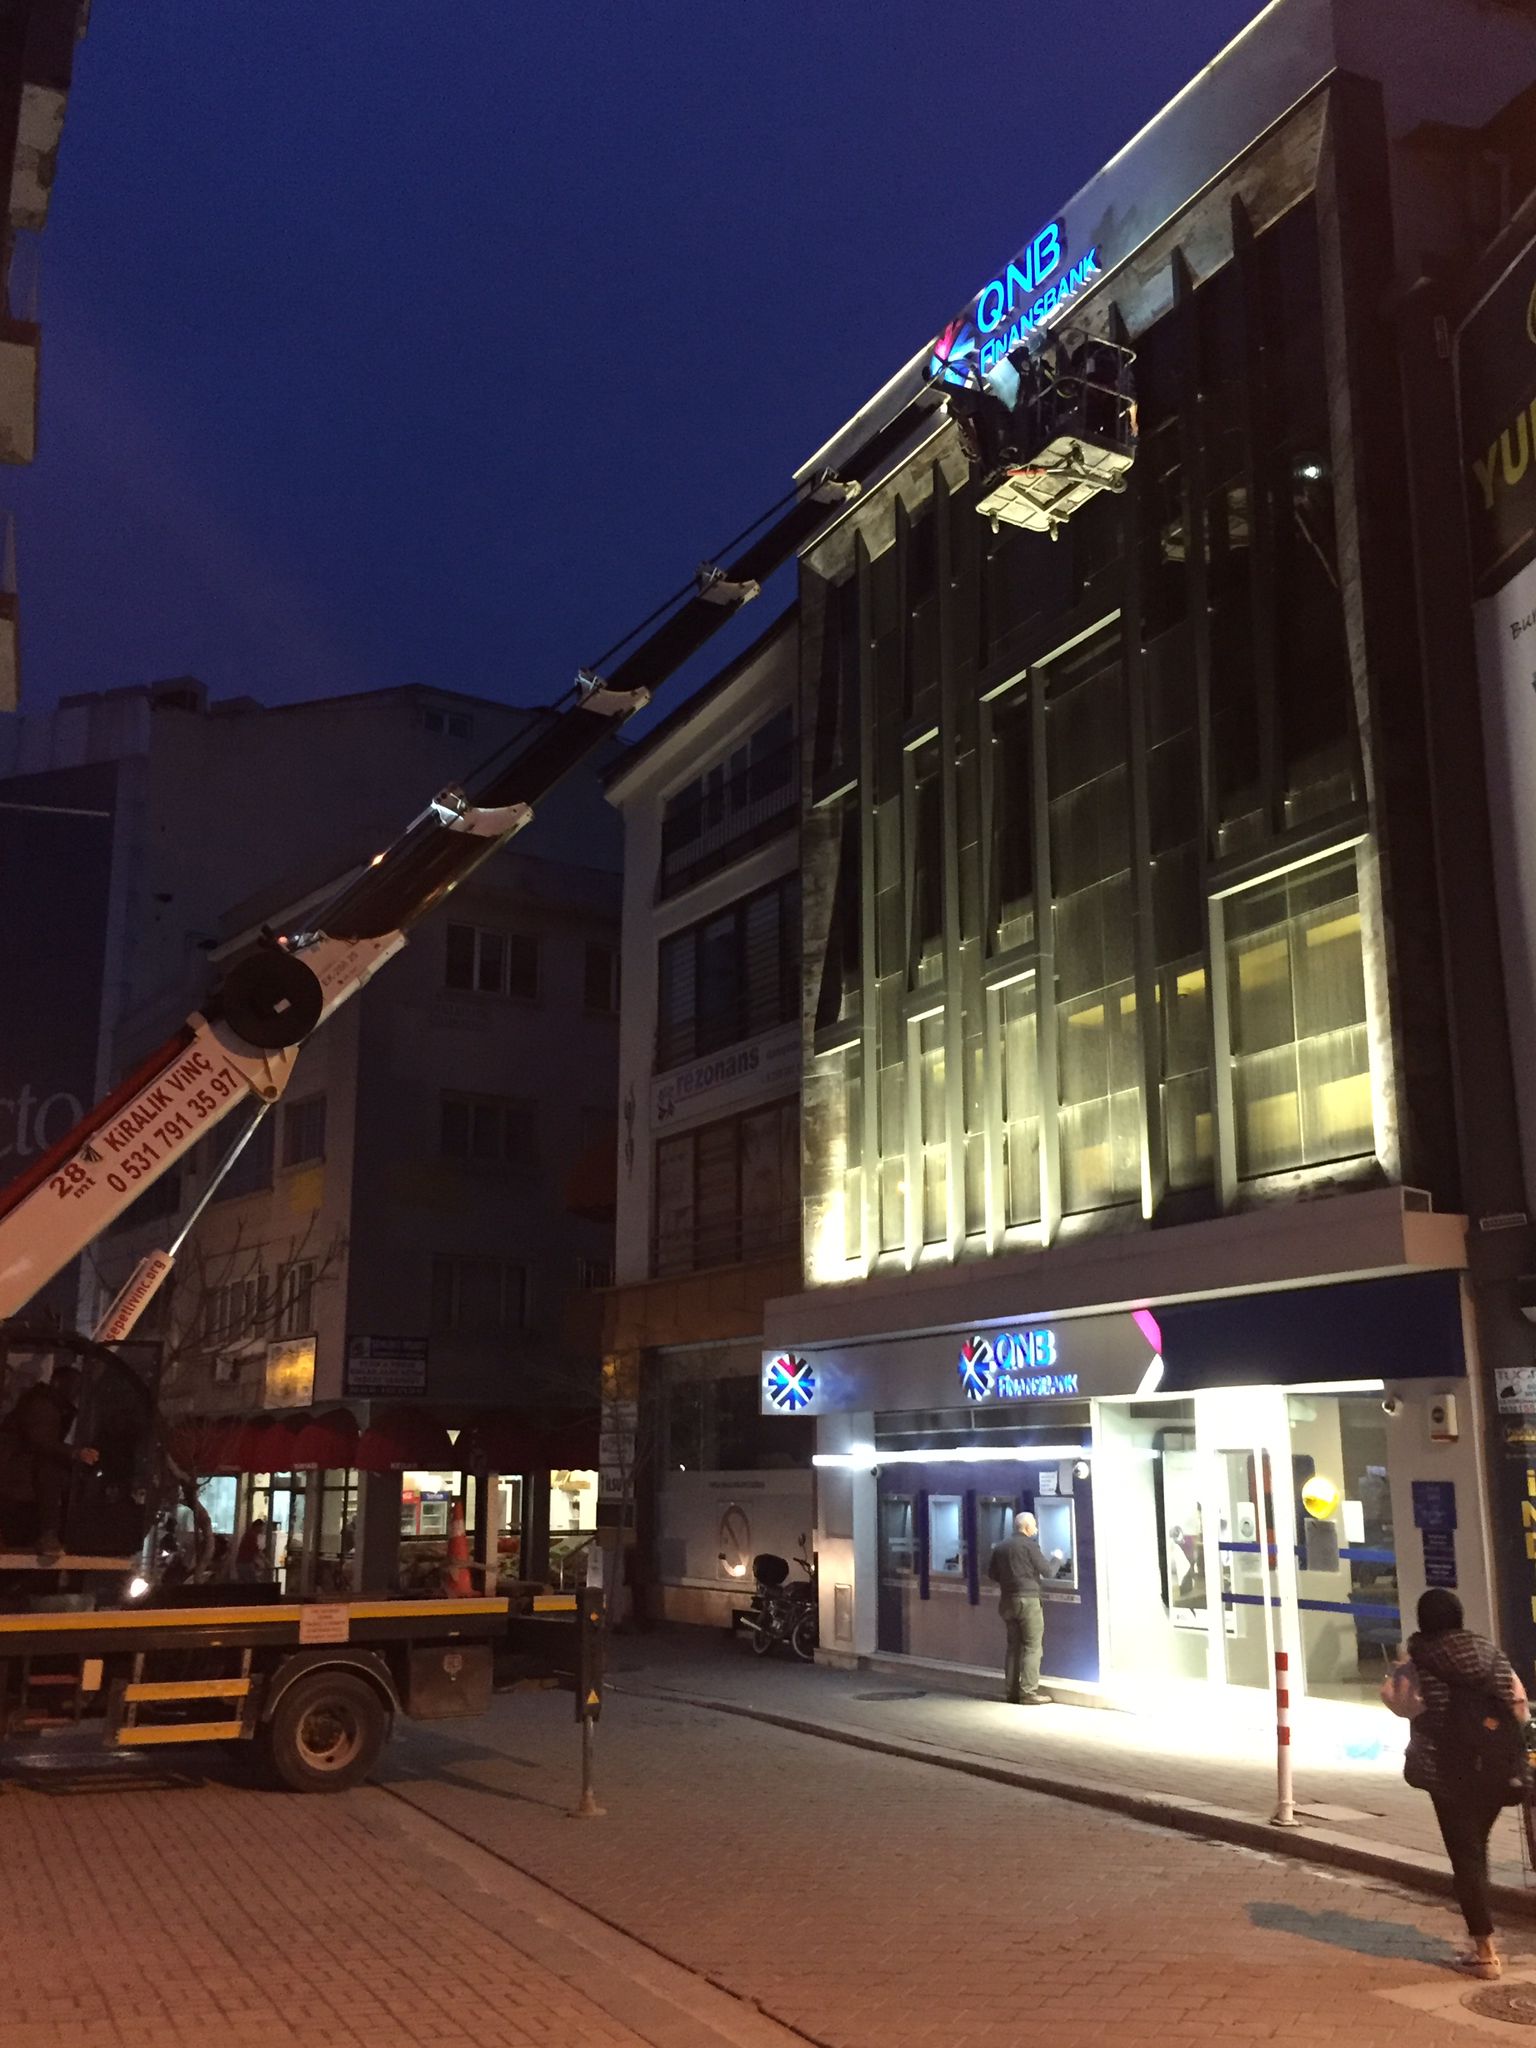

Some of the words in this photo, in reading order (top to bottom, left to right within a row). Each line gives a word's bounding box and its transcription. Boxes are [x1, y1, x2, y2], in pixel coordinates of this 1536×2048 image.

[976, 222, 1061, 334] QNB
[106, 1172, 128, 1194] 0
[119, 1141, 161, 1181] 531
[153, 1111, 194, 1149] 791
[187, 1089, 218, 1119] 35
[210, 1067, 239, 1098] 97
[49, 1162, 87, 1200] 28
[72, 1176, 97, 1199] mt
[993, 1329, 1057, 1371] QNB
